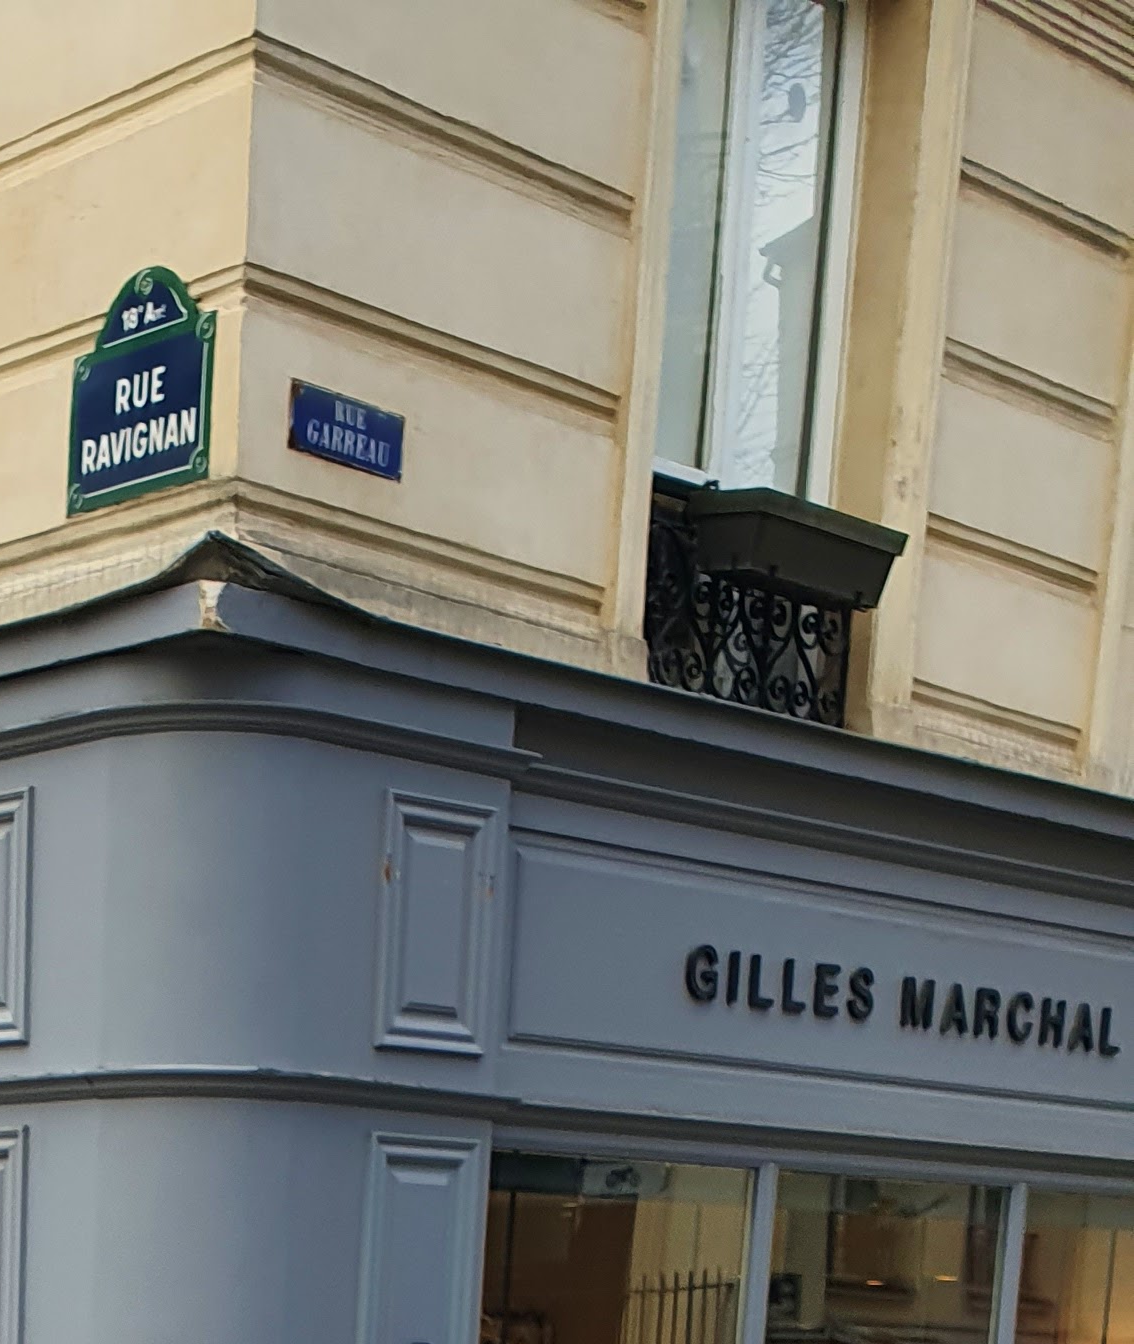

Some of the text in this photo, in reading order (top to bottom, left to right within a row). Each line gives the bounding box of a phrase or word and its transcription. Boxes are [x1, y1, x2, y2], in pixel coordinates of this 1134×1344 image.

[114, 365, 167, 416] RUE
[333, 400, 366, 429] RUE
[80, 406, 198, 475] RAVIGNAN
[306, 418, 391, 468] GARREAU
[682, 943, 1122, 1058] GILLES MARCHAL
